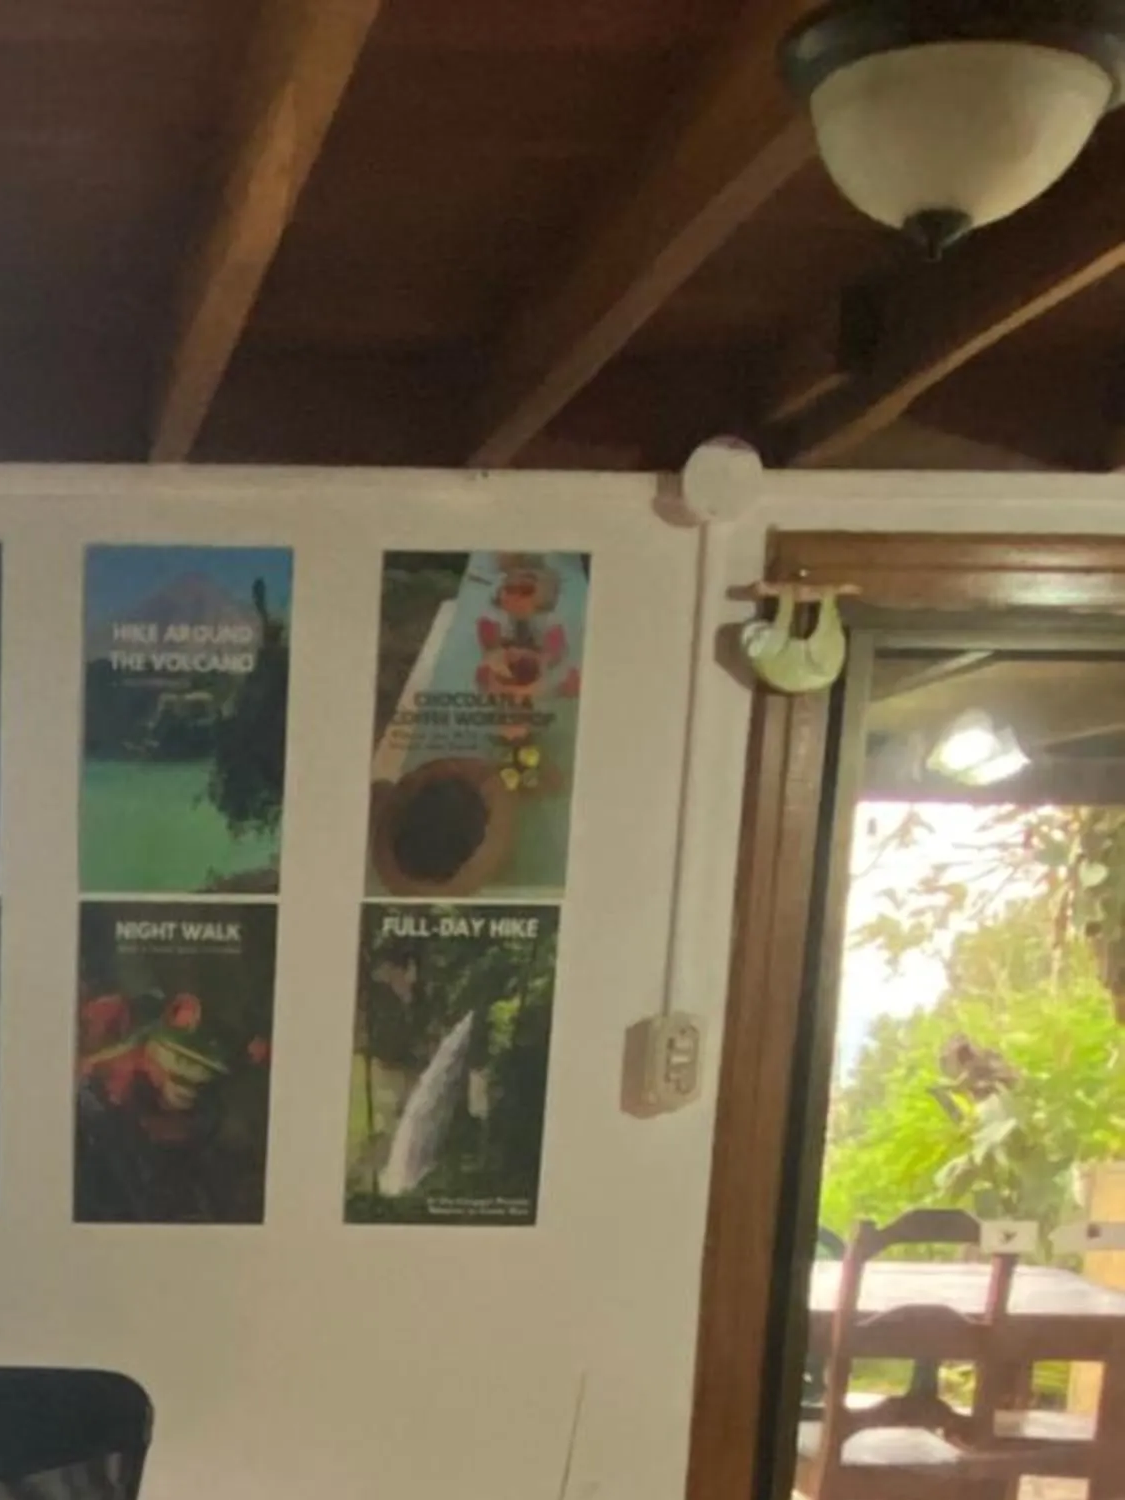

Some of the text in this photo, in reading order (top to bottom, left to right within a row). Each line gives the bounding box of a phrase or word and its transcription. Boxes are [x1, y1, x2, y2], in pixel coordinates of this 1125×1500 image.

[113, 622, 253, 644] HIKE AROUND
[109, 650, 254, 673] THE VOLCANO
[115, 921, 241, 941] NIGHT WALK
[382, 916, 539, 938] FULL-DAY HIKE
